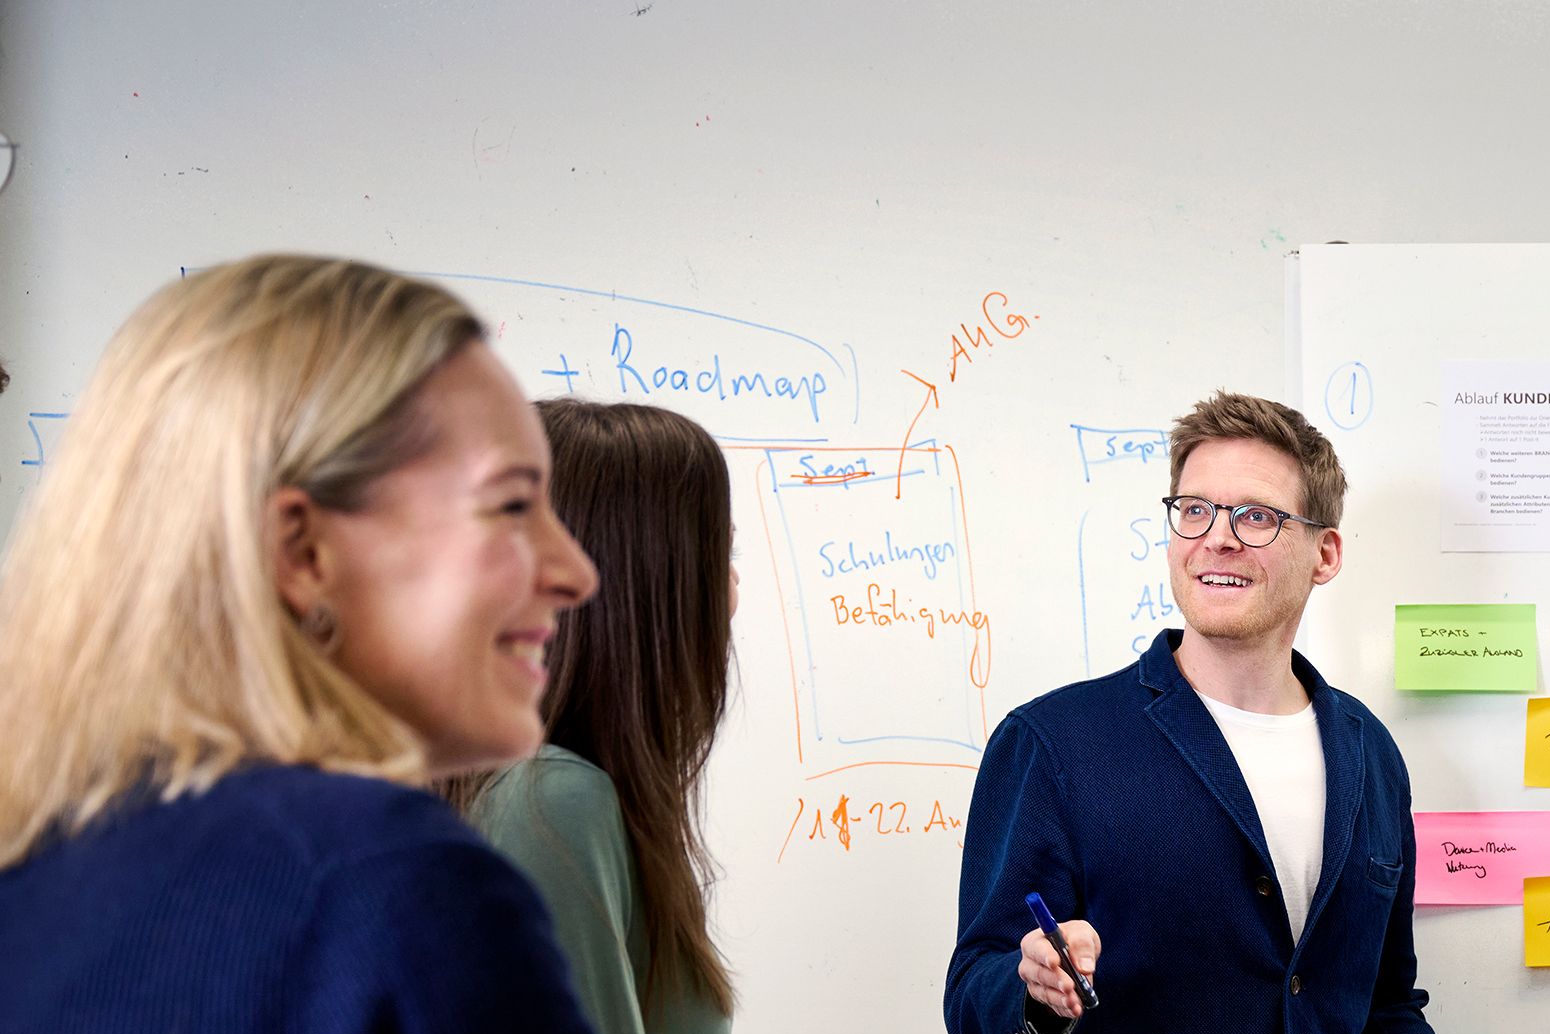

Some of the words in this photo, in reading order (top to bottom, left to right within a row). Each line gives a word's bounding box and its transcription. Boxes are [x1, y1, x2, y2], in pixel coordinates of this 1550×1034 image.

[612, 323, 827, 422] Roadmap
[1454, 391, 1499, 405] Ablauf
[819, 531, 955, 580] Schulungen
[1419, 628, 1469, 637] EXPATS
